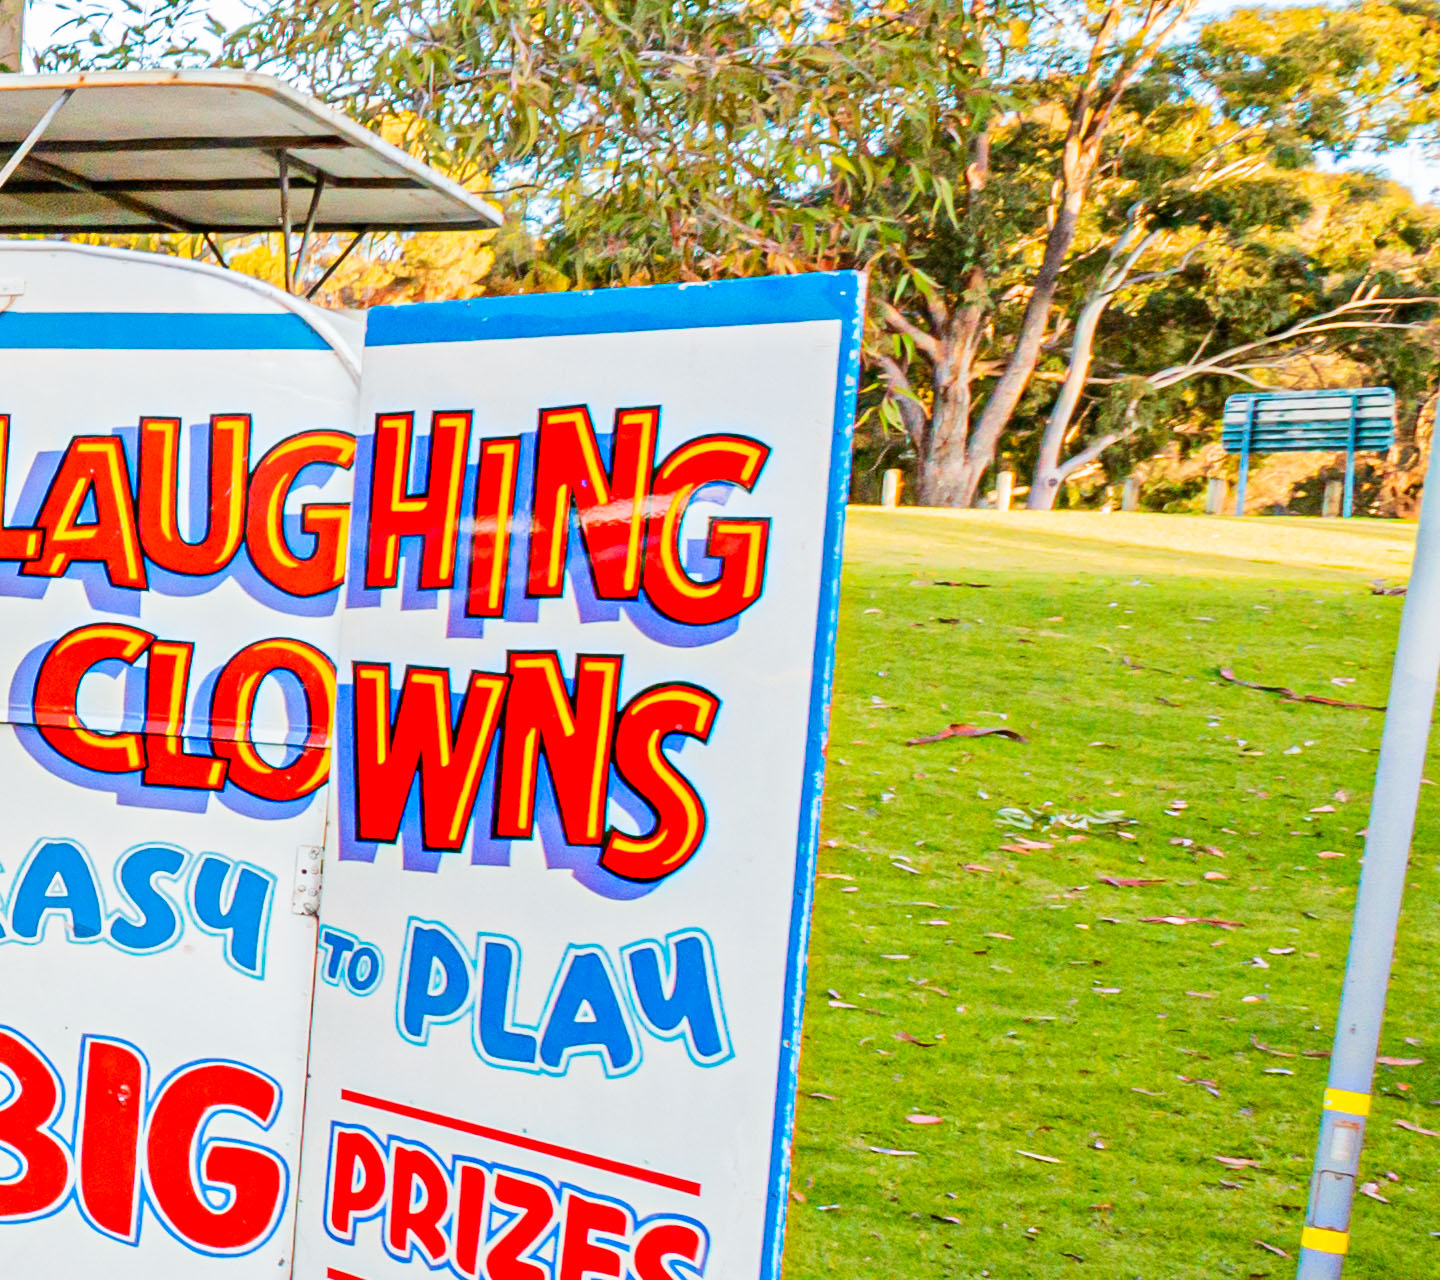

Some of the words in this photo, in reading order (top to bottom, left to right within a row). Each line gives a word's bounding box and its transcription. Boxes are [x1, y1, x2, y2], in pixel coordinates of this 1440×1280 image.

[33, 622, 722, 882] CLOWNS
[323, 931, 379, 990] TO
[404, 927, 722, 1073] PLAY
